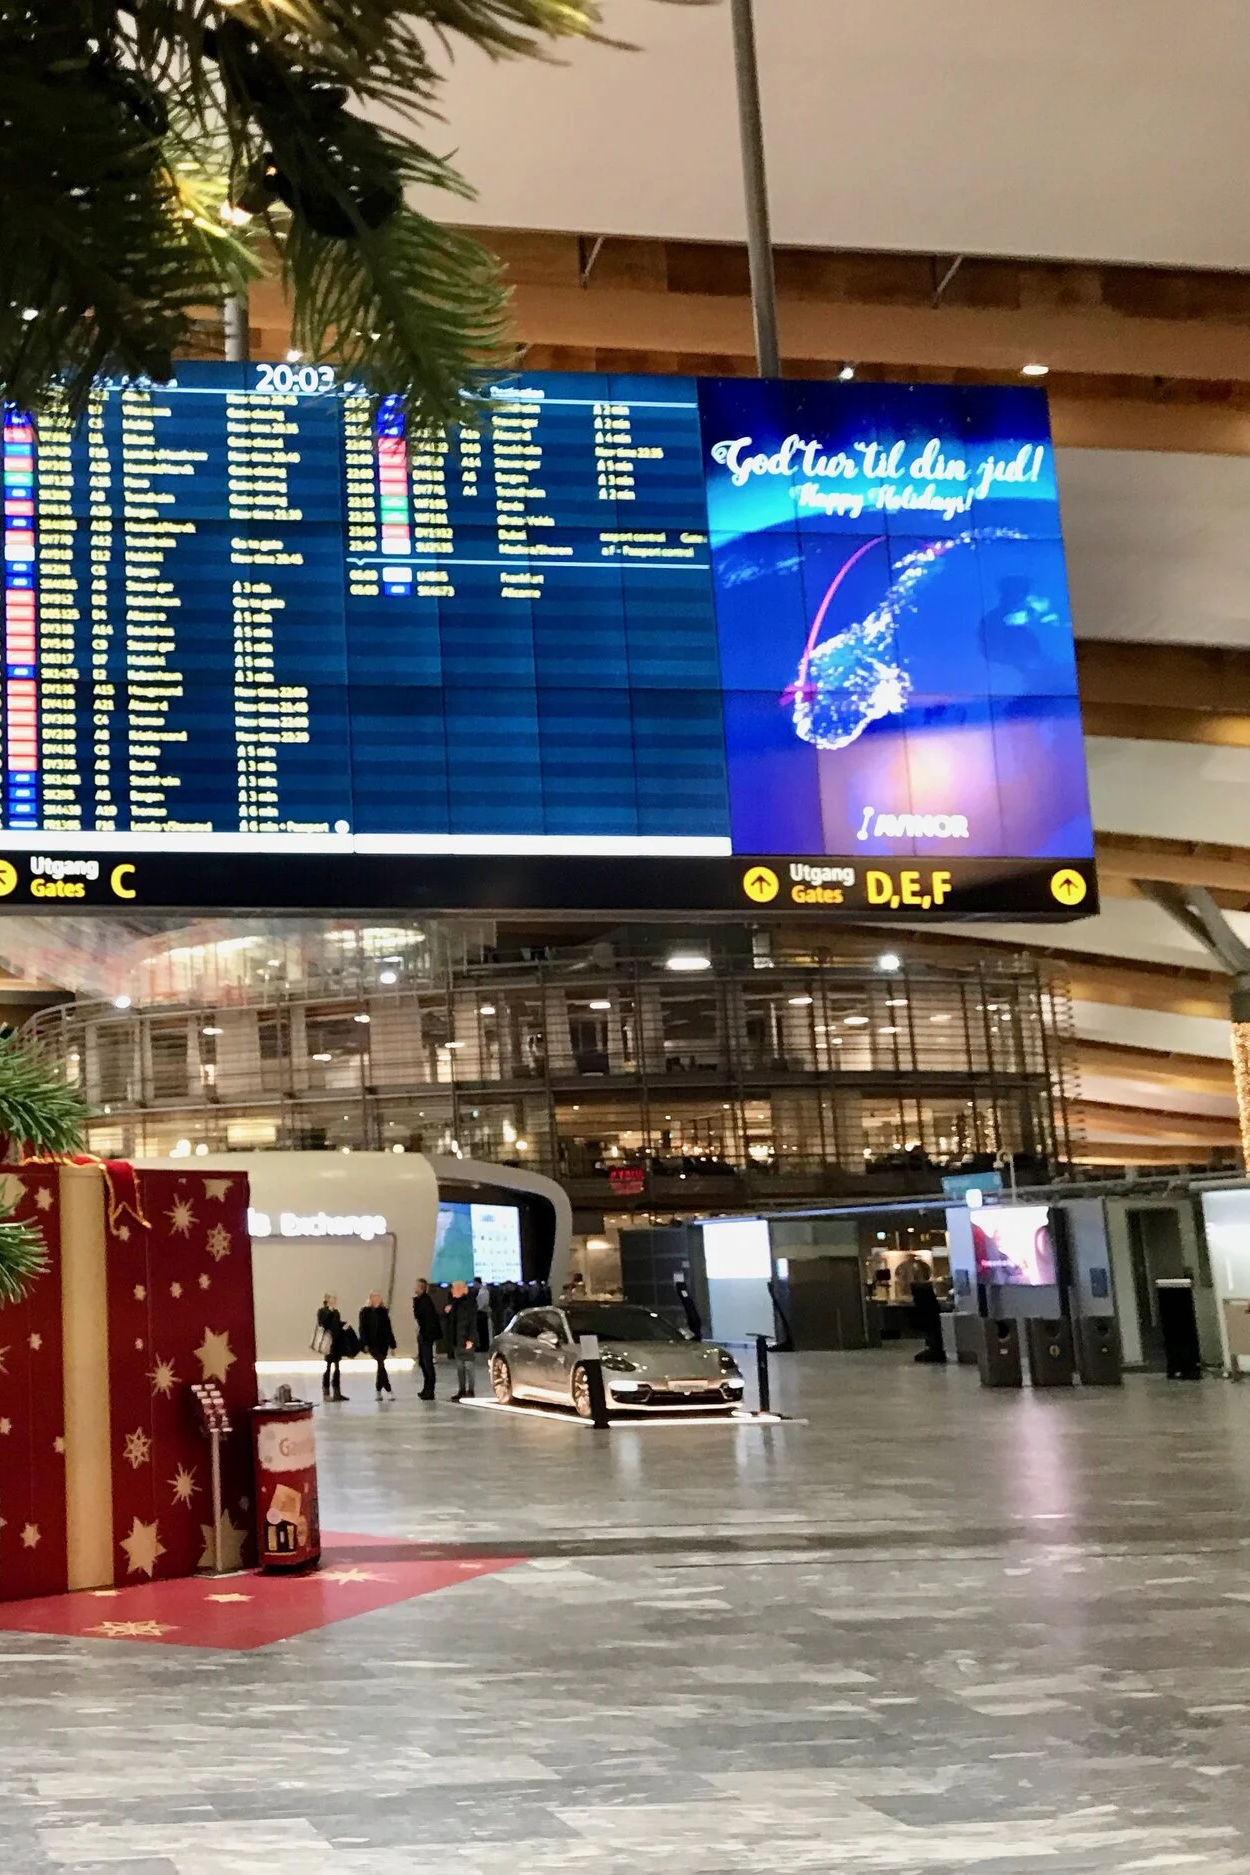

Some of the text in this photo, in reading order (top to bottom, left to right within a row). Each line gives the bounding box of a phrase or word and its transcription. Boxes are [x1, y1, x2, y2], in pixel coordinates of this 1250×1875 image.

[711, 435, 798, 487] God
[800, 439, 858, 479] tur
[855, 438, 906, 479] til
[910, 437, 970, 481] din
[30, 856, 100, 880] Utgang
[110, 864, 137, 899] C
[789, 863, 855, 887] Utgang
[30, 879, 86, 898] Gates
[791, 886, 844, 904] Gates
[865, 870, 952, 909] D,E,F
[280, 1211, 387, 1241] Exchange
